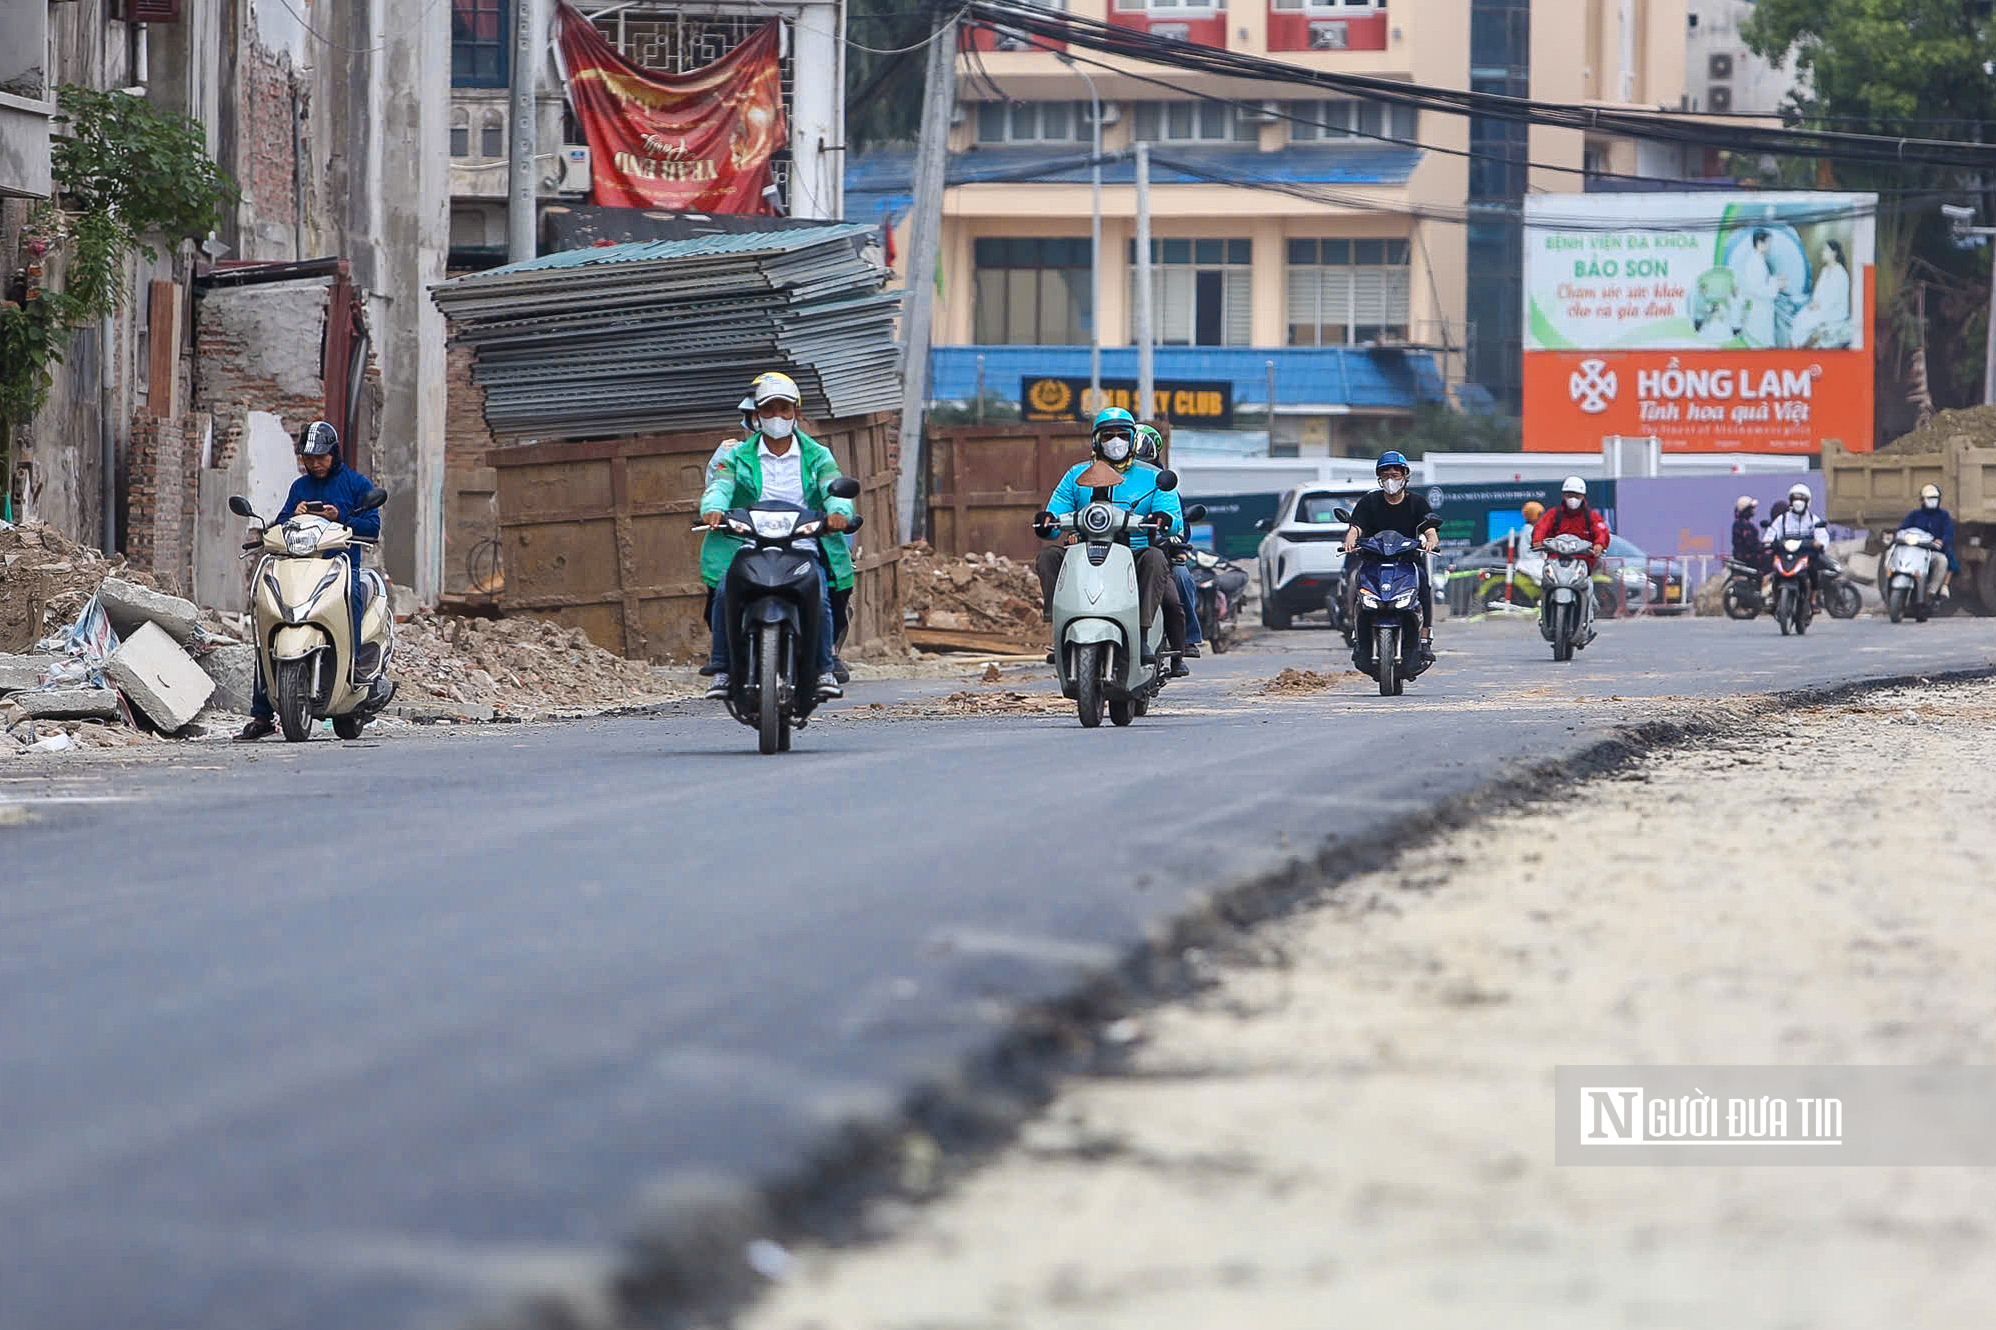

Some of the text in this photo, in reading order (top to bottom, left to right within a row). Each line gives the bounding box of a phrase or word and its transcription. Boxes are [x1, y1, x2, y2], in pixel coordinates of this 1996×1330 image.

[1573, 254, 1618, 278] BẢO
[1637, 356, 1811, 398] HỒNG LAM
[1174, 389, 1223, 416] CLUB
[1639, 401, 1680, 421] Tinh
[1687, 402, 1725, 421] hoa
[1773, 400, 1810, 427] Việt
